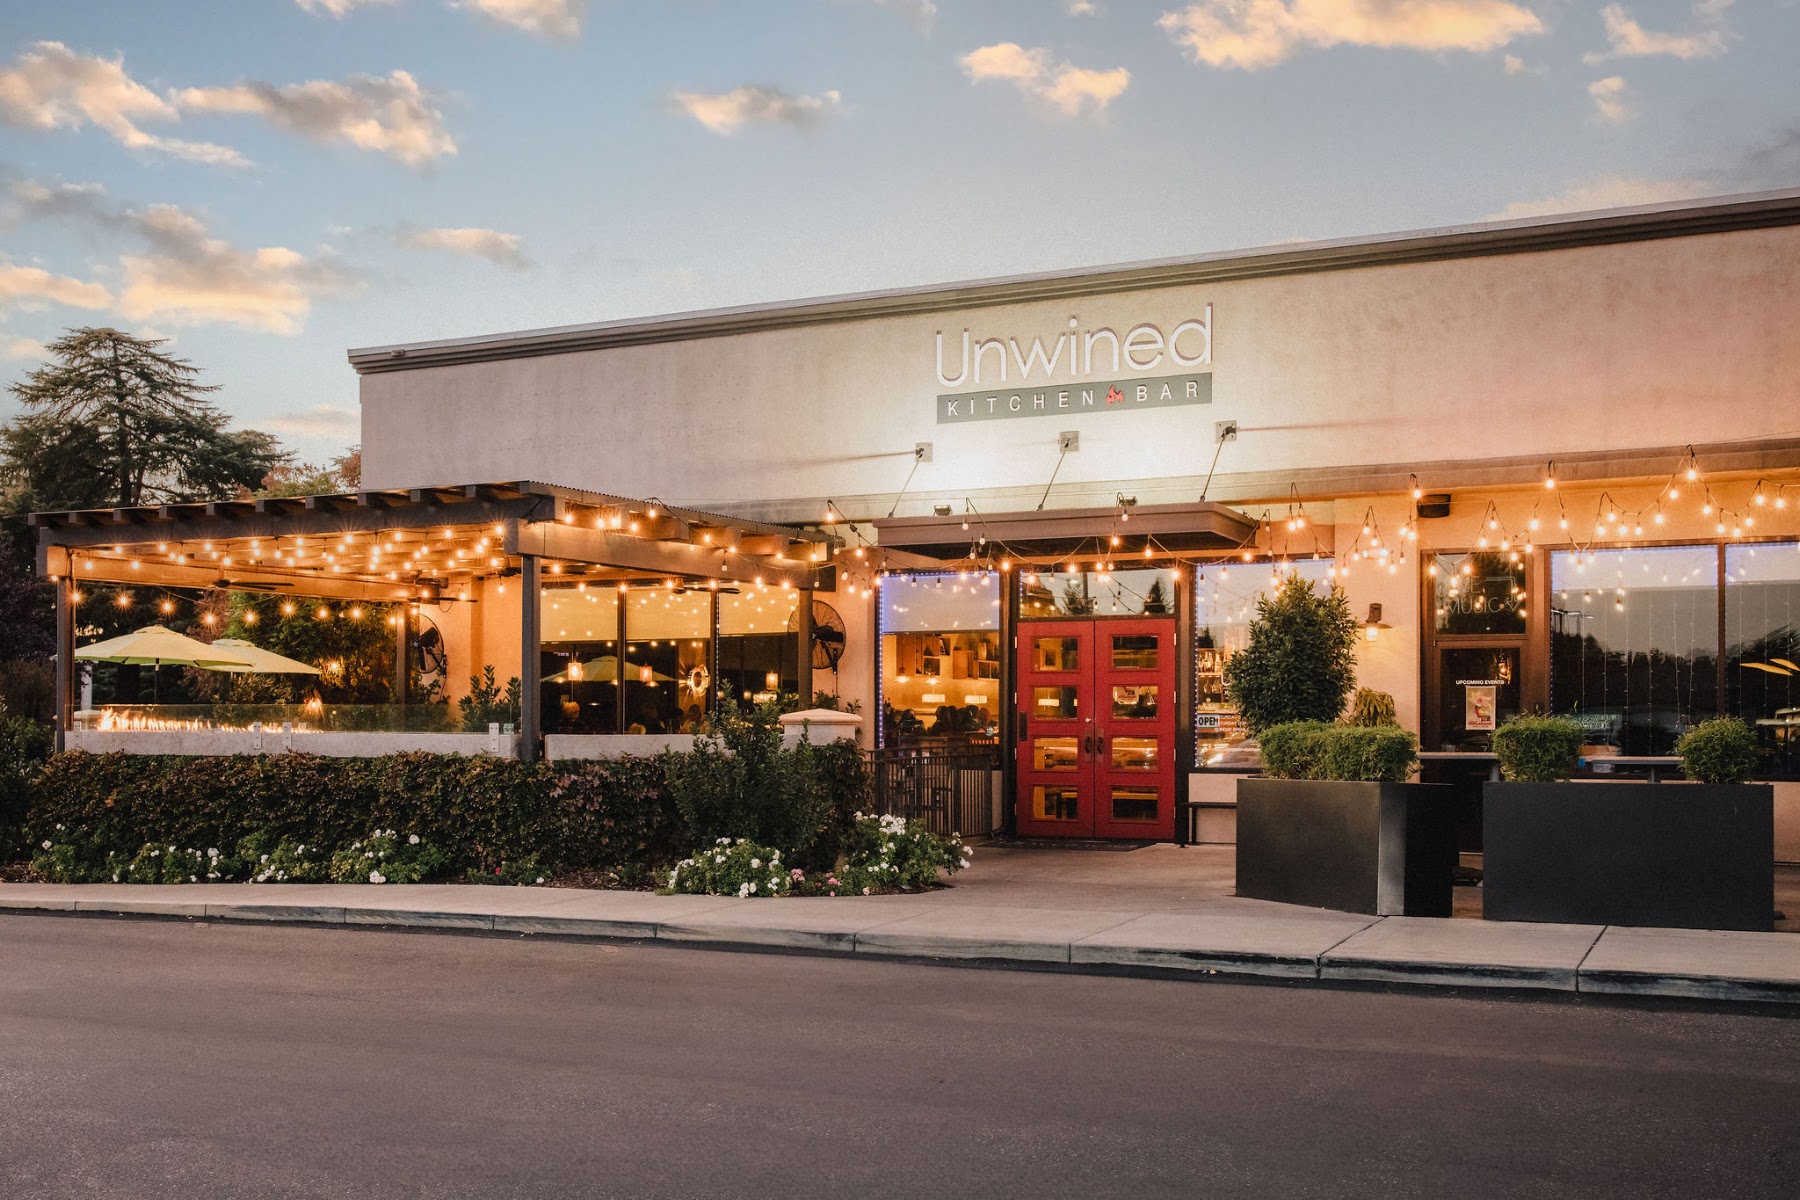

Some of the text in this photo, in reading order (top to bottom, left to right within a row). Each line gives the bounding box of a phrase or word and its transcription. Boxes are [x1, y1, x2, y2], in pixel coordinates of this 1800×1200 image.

[936, 303, 1213, 387] Unwined
[948, 380, 1199, 416] KITCHEN BAR
[1446, 597, 1501, 615] MUSIC
